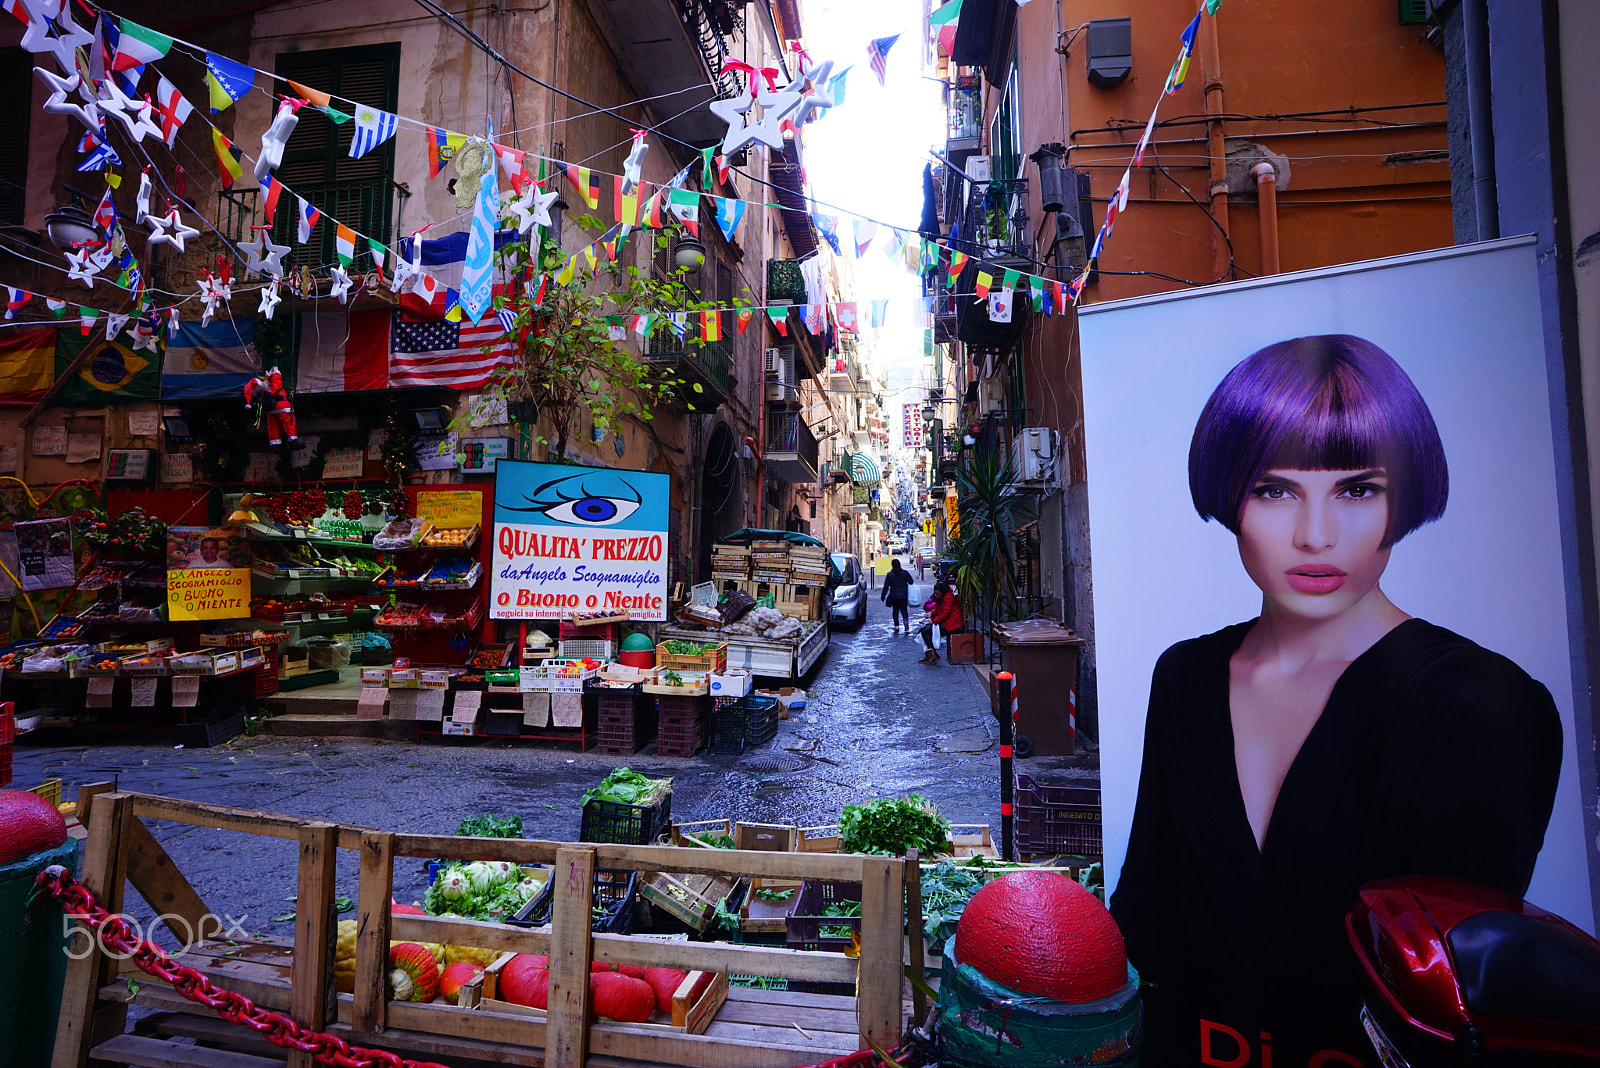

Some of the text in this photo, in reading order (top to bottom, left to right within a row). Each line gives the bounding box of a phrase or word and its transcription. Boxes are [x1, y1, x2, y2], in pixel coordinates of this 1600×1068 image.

[499, 527, 662, 561] QUALITA' PREZZO
[170, 570, 232, 580] DA ANGELO
[572, 565, 661, 588] Scognamiglio
[169, 579, 242, 591] SCOGNAMIGLIO
[171, 588, 224, 602] O BUONO
[497, 589, 662, 609] o Buono o Niente
[186, 598, 242, 611] O NIENTE
[496, 610, 524, 619] seguici
[1058, 811, 1093, 820] INGENITO
